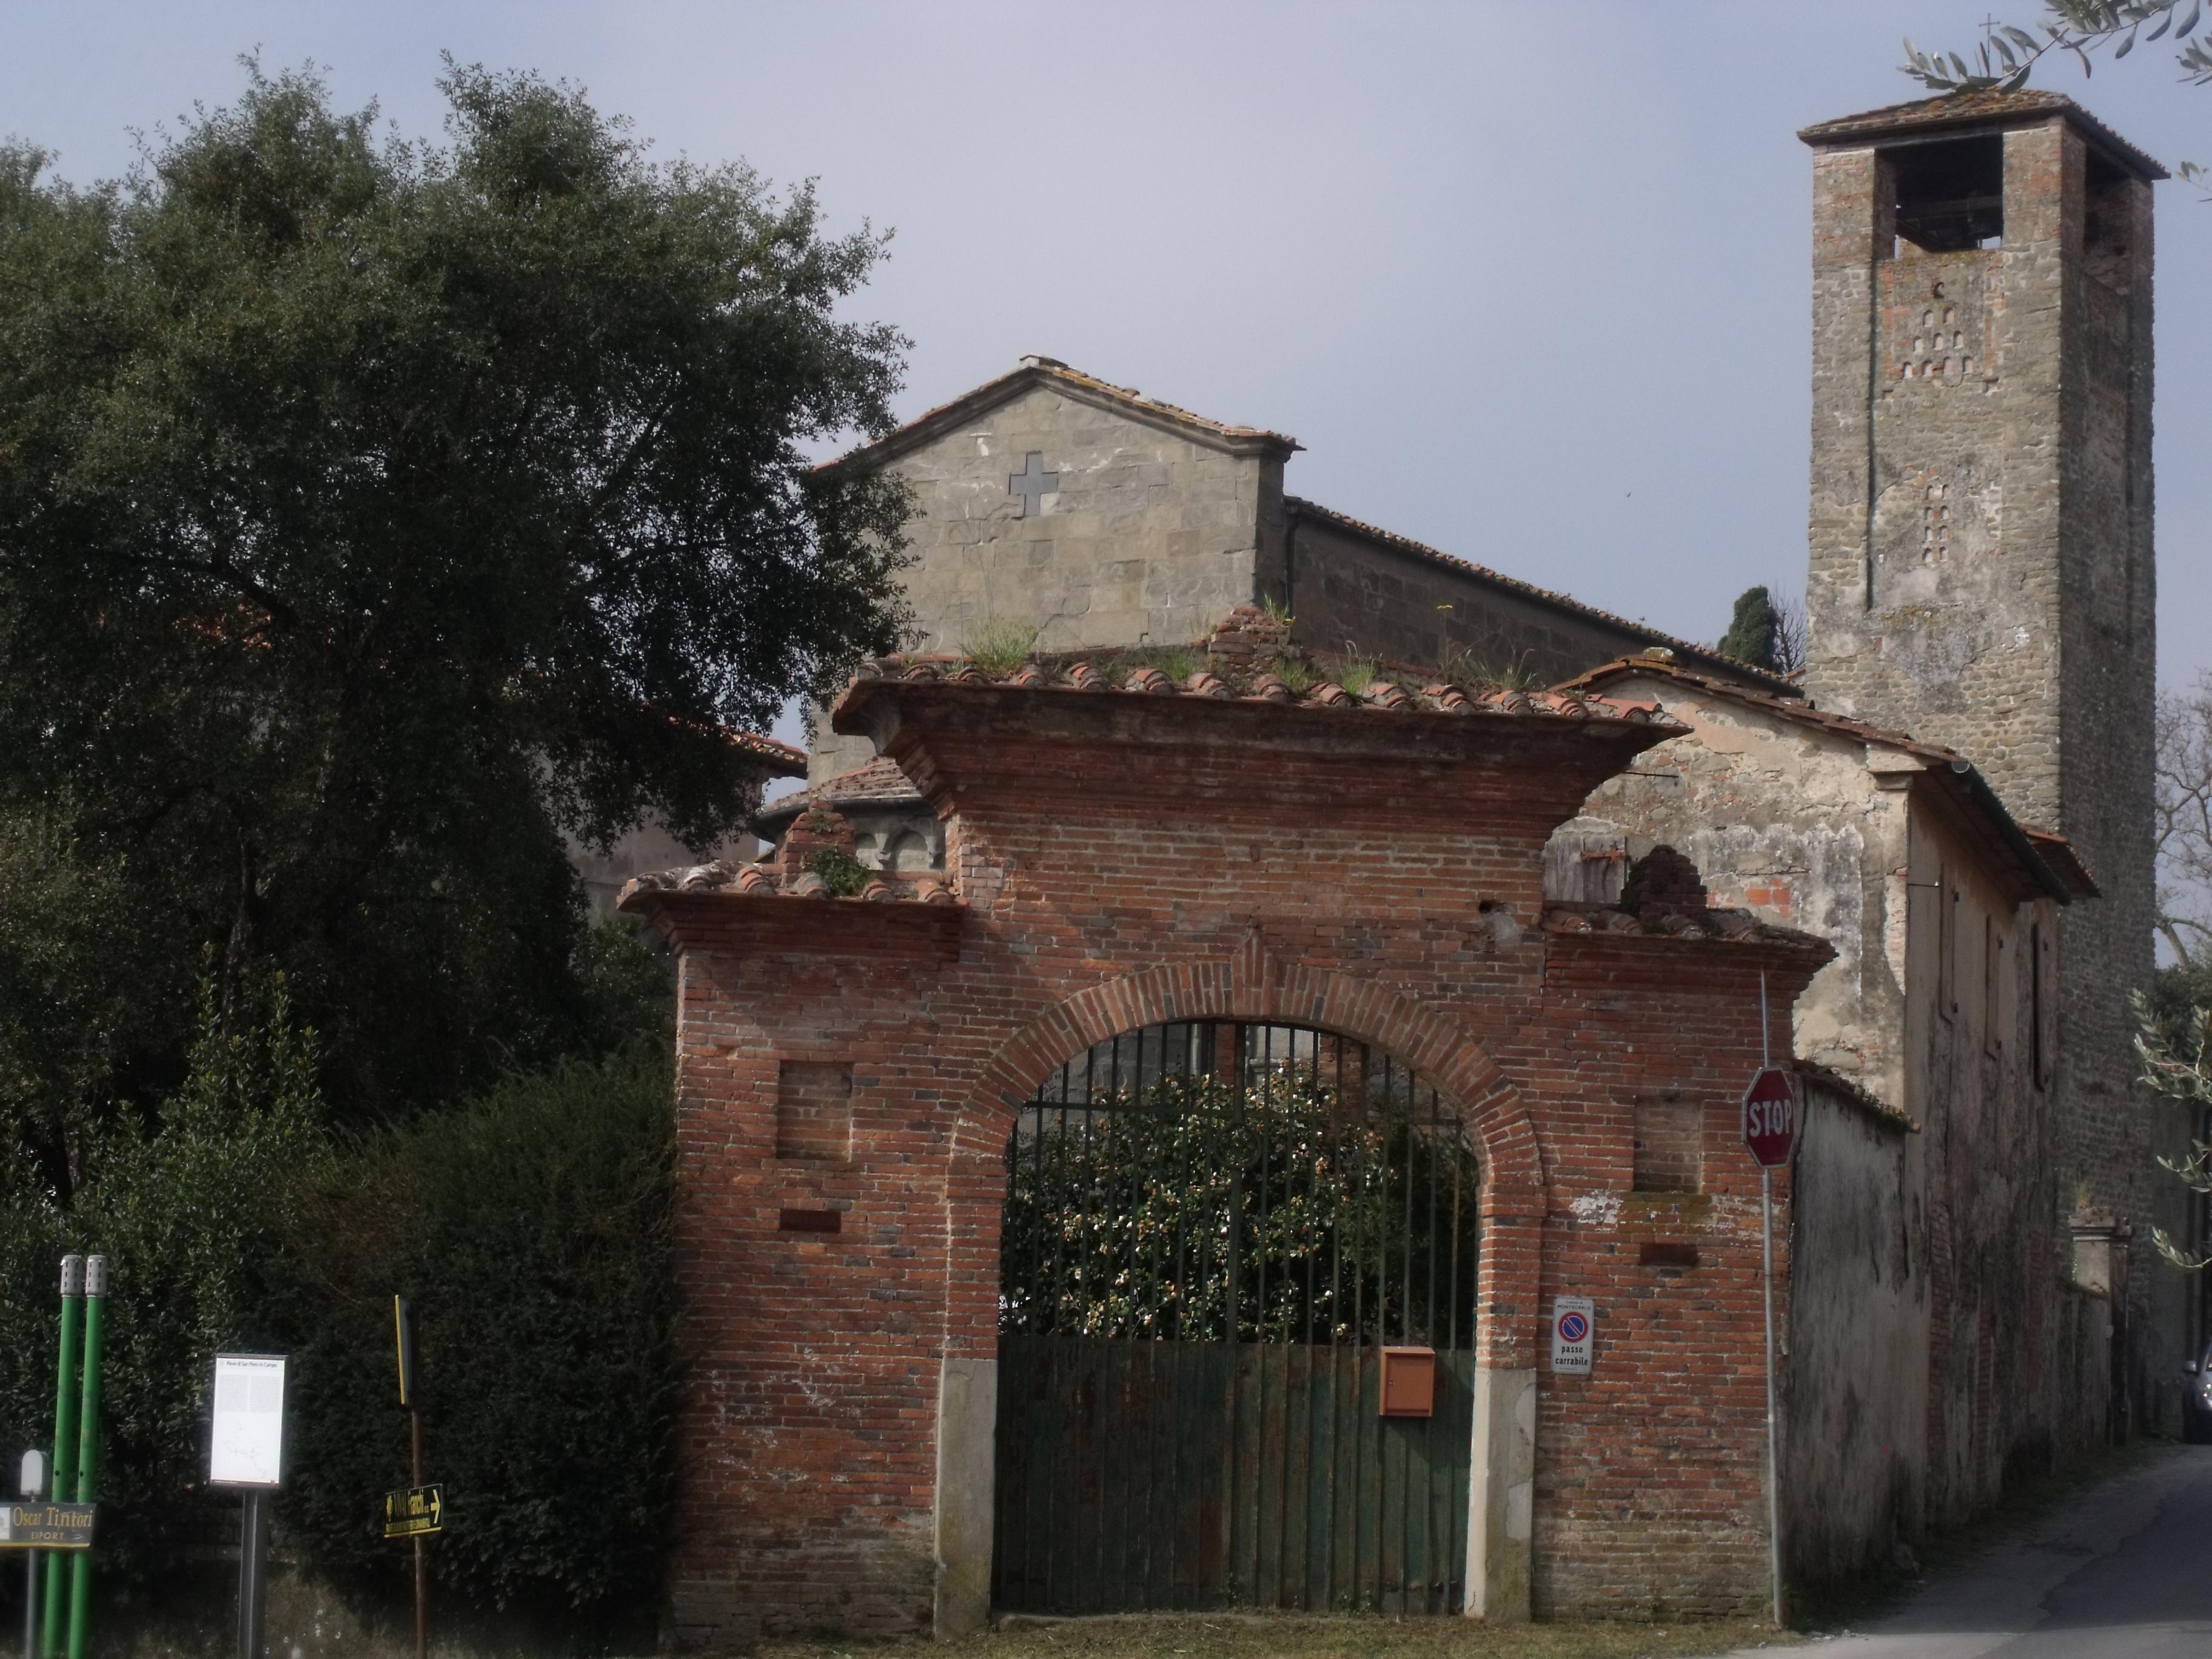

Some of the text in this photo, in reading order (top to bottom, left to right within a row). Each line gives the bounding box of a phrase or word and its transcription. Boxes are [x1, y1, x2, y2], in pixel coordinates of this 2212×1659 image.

[1749, 1099, 1792, 1138] STOP
[1561, 1346, 1583, 1355] passo
[1555, 1357, 1589, 1366] carrabile
[13, 1507, 93, 1527] Oscar Tintori
[32, 1532, 65, 1540] EXPORT
